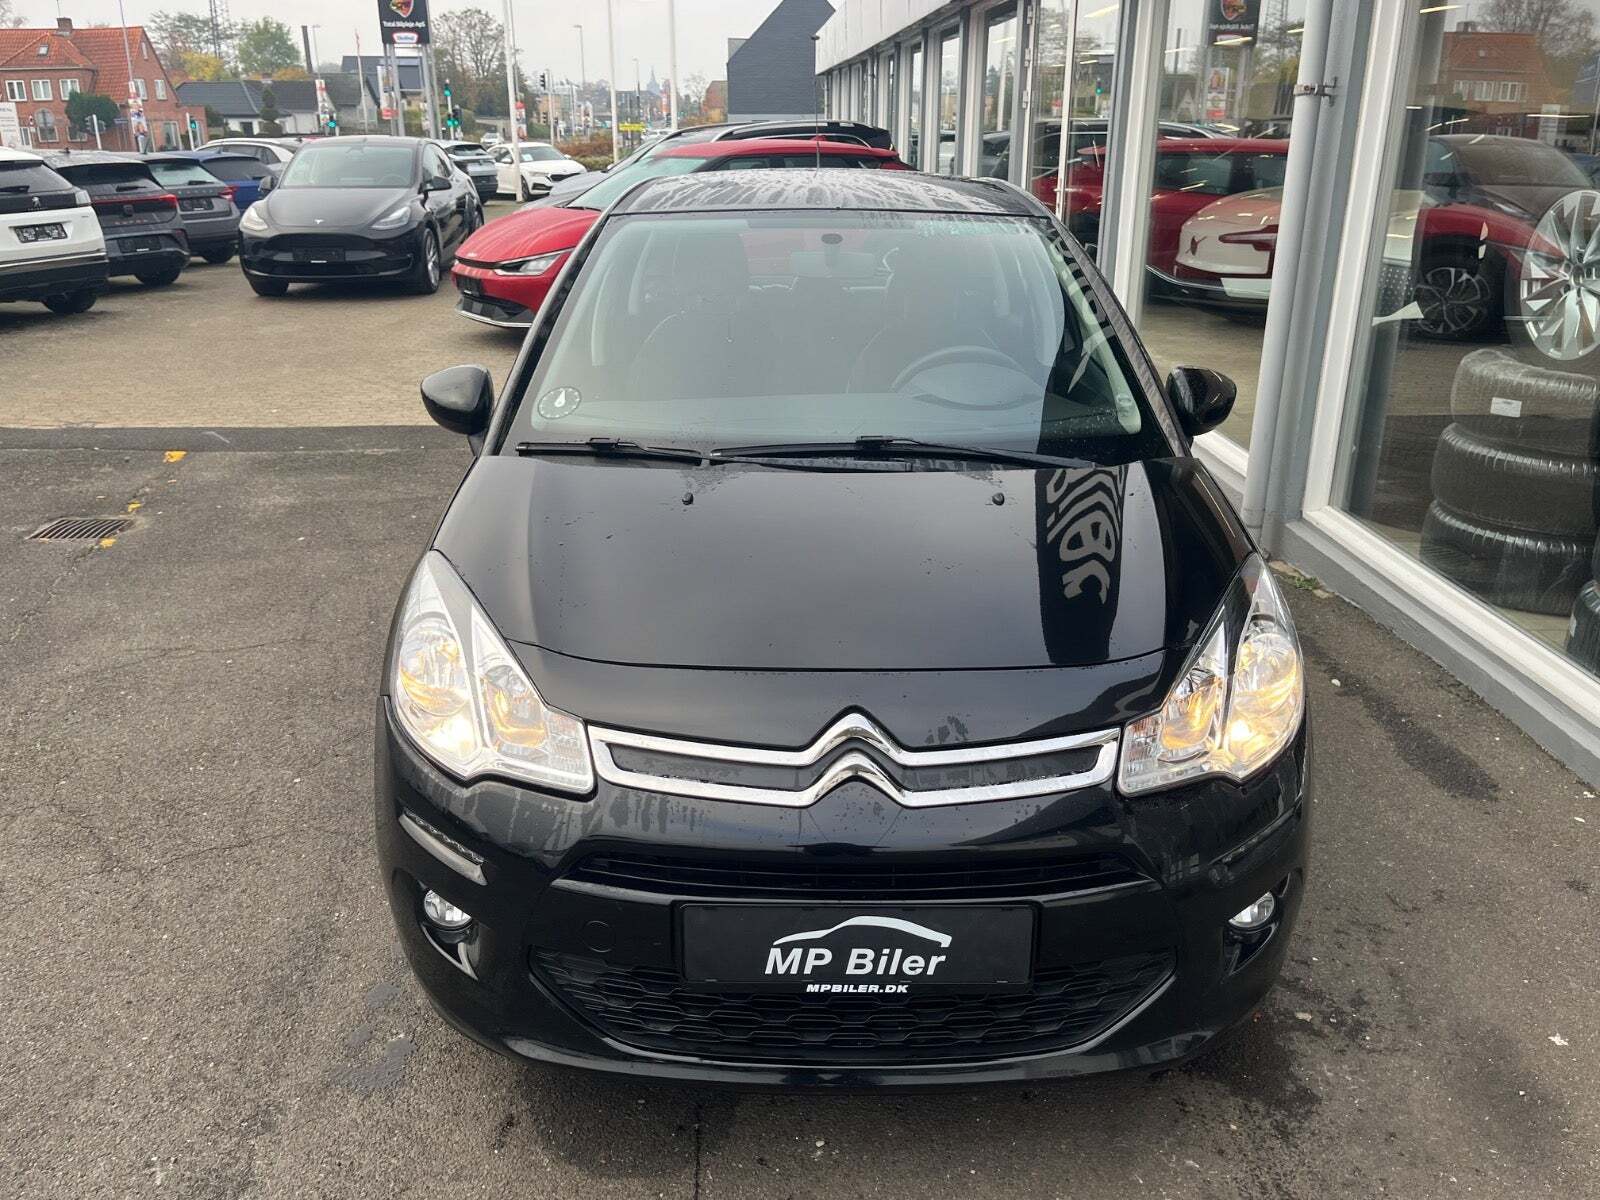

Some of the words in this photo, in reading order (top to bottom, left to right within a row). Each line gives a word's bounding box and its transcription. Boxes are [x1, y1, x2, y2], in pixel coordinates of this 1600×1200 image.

[764, 947, 833, 975] MP
[845, 947, 947, 975] Biler
[806, 984, 910, 993] MPBILER.DK
